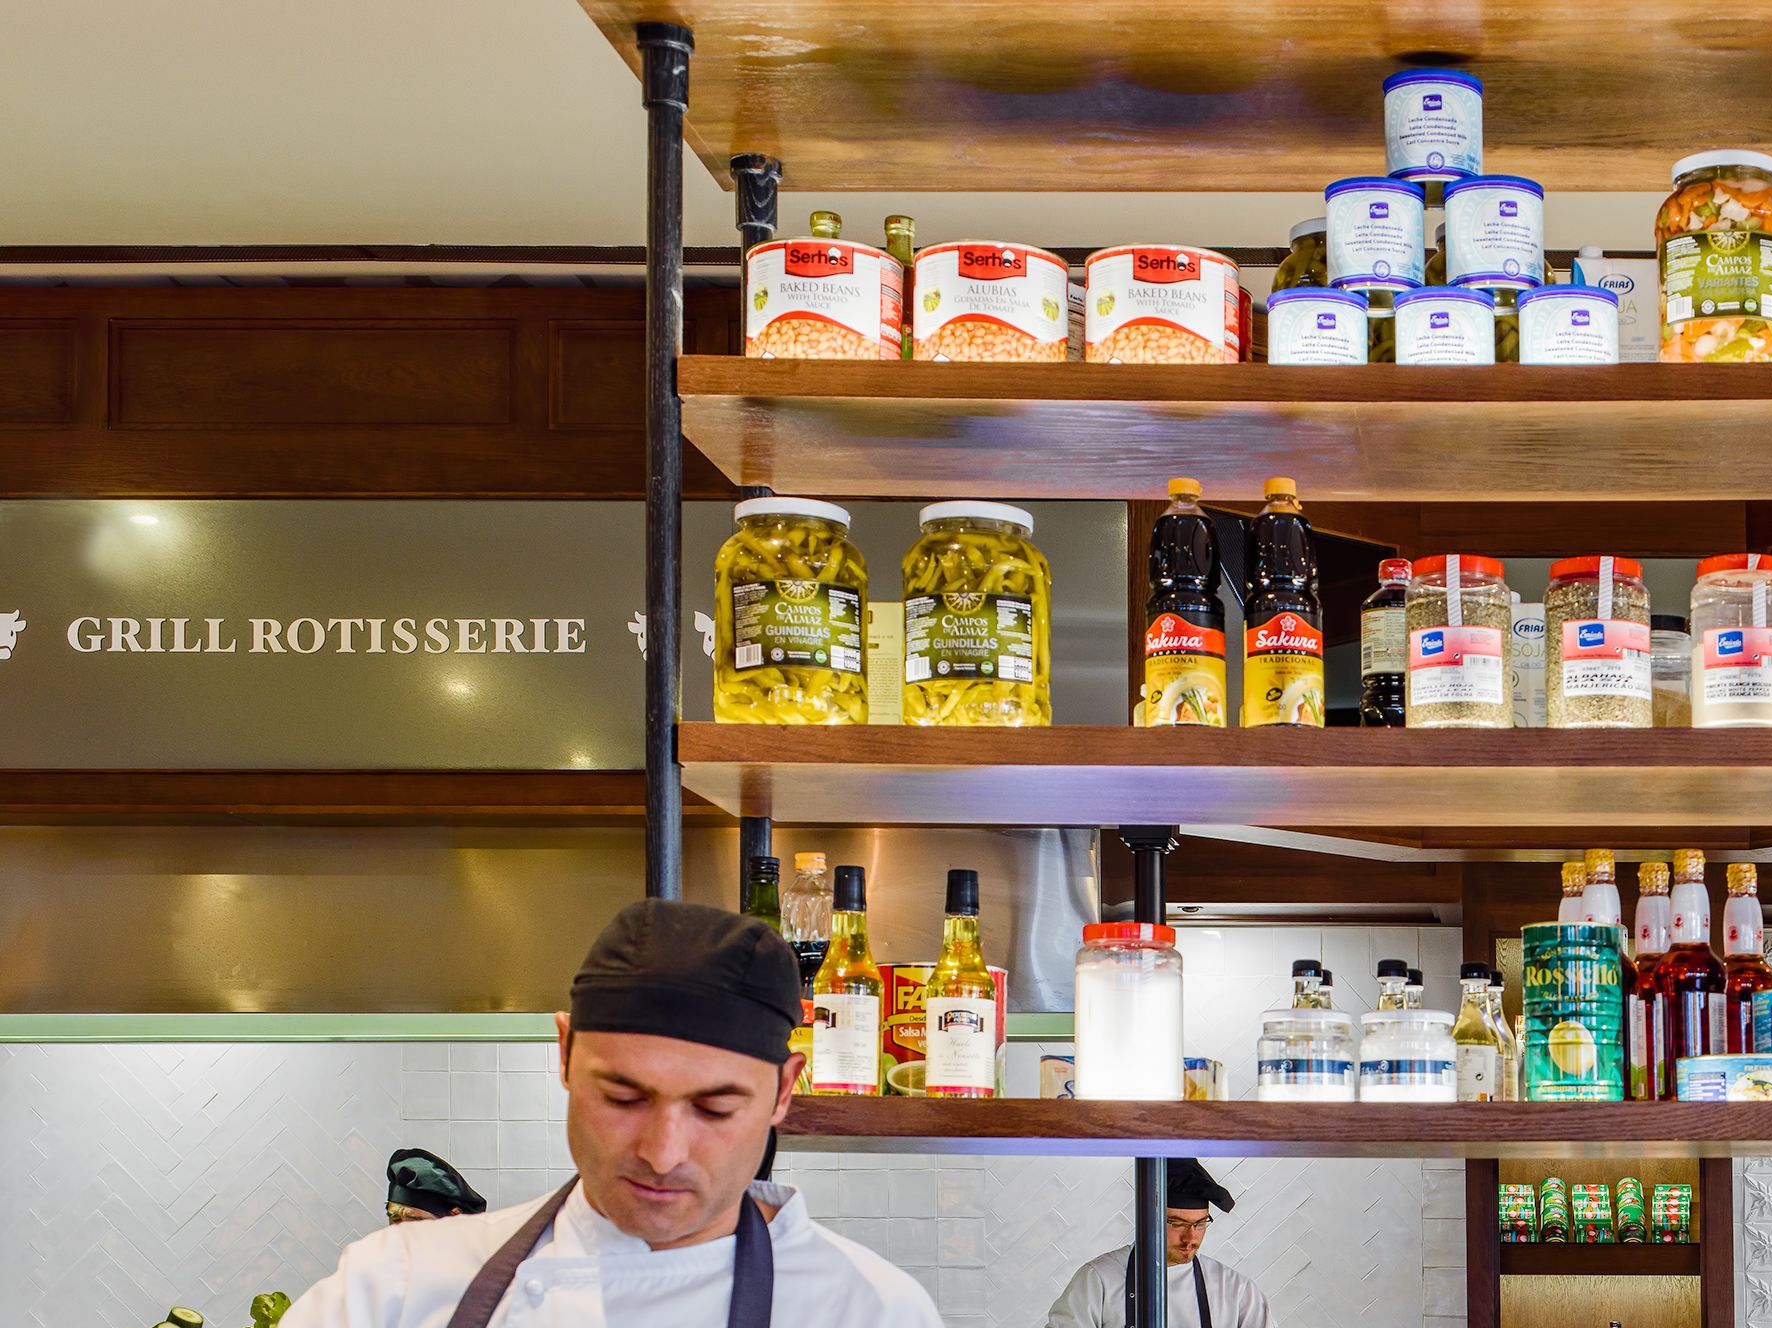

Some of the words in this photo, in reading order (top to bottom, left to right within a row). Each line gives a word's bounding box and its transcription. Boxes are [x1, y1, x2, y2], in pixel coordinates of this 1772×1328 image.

[789, 248, 848, 267] Serhos
[963, 250, 1022, 271] Serhos
[1138, 253, 1196, 273] Serhos
[1706, 254, 1752, 266] CAMPOS
[1717, 264, 1752, 275] ALMAZ
[1603, 281, 1630, 289] FRIAS
[1697, 276, 1760, 289] VARIANTES
[780, 282, 819, 294] BAKED
[822, 284, 861, 297] BEANS
[967, 285, 1017, 298] ALUBIAS
[1128, 287, 1168, 299] BAKED
[1171, 288, 1207, 304] BEANS
[775, 602, 822, 615] CAMPOS
[785, 612, 822, 627] ALMAZ
[941, 614, 989, 628] CAMPOS
[66, 616, 237, 654] GRILL
[248, 616, 588, 654] ROTISSERIE
[765, 624, 832, 639] GUINDILLAS
[951, 625, 989, 637] ALMAZ
[774, 636, 787, 644] EN
[790, 636, 824, 647] VINAGRE
[932, 637, 999, 649] GUINDILLAS
[1146, 632, 1204, 651] Sakura
[1255, 630, 1318, 650] Sakura
[957, 648, 990, 658] VINAGRE
[1259, 656, 1316, 666] TRADICIONAL
[1526, 964, 1618, 987] Rosselló
[899, 1027, 920, 1038] Salsa
